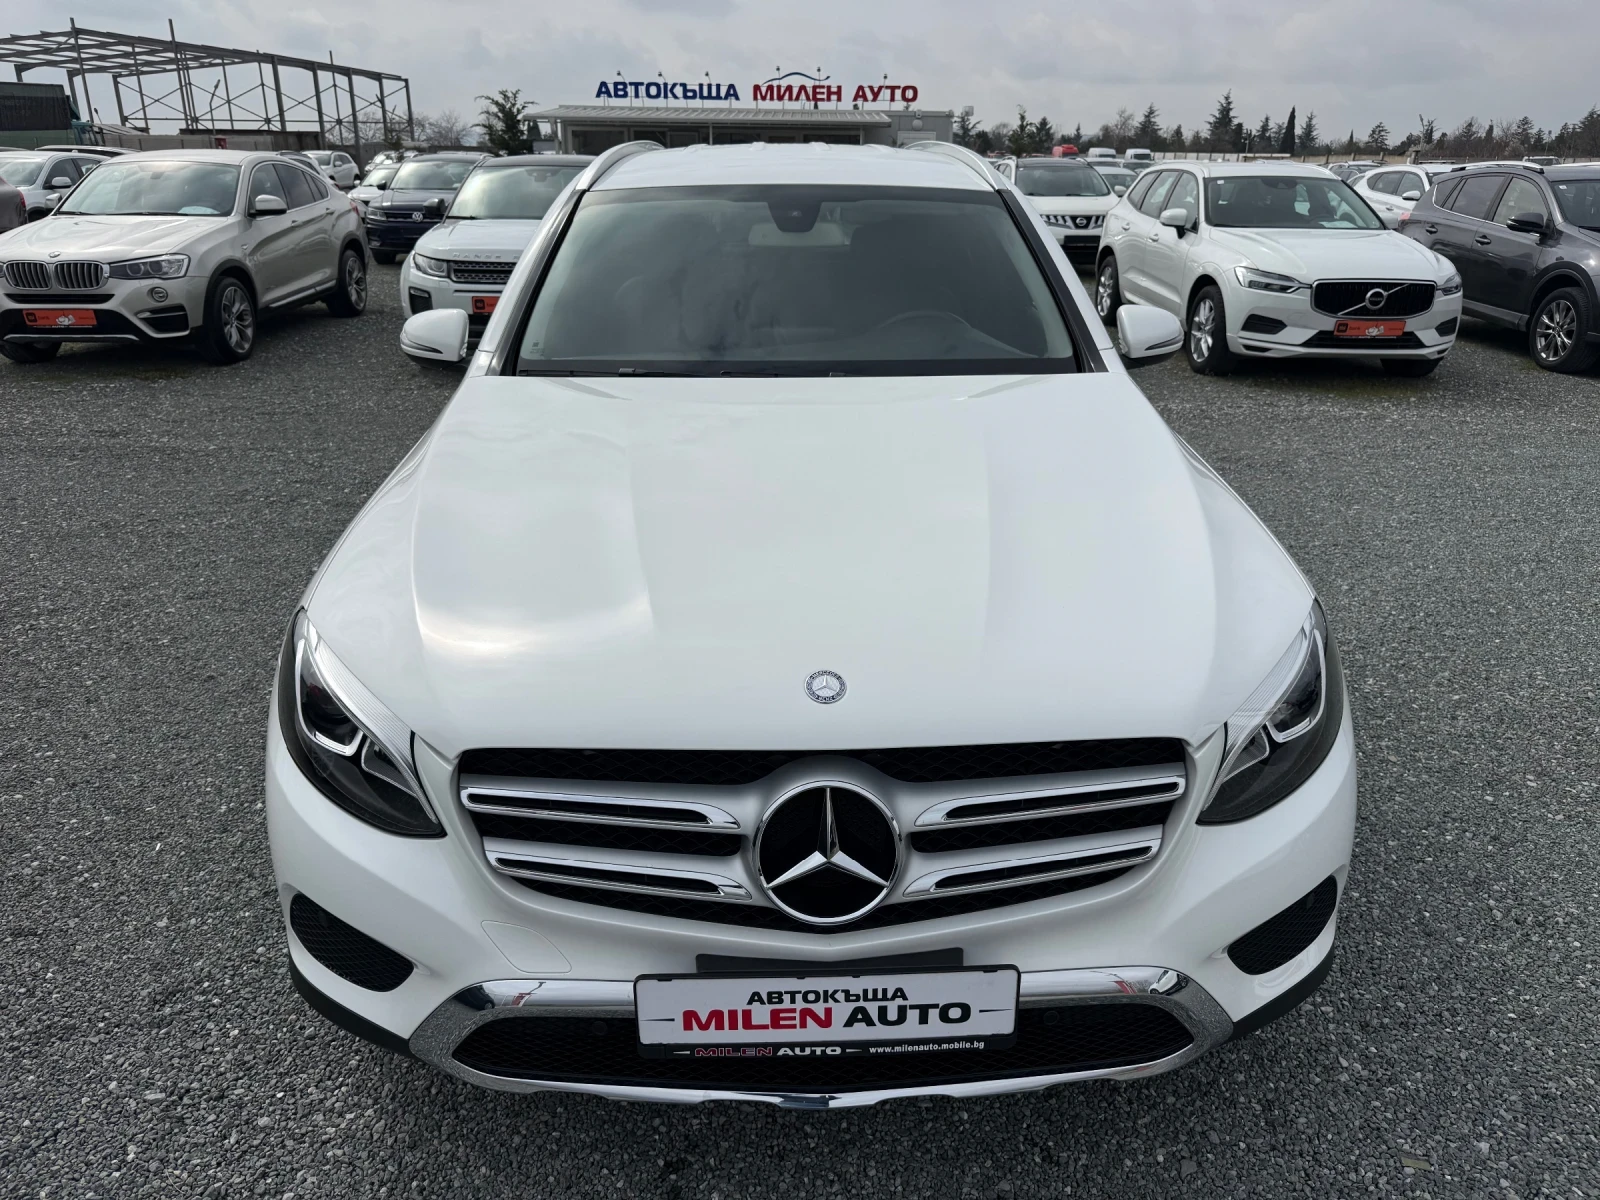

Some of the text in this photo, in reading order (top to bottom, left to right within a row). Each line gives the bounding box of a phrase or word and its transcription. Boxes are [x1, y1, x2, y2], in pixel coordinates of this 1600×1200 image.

[595, 81, 918, 103] АВТОКЪЩА МИЛЕН АУТО
[746, 987, 909, 1006] АВТОКЪЩА
[682, 1001, 972, 1031] MILEN AUTO
[694, 1046, 842, 1057] MILEN AUTO
[869, 1040, 985, 1054] www.milenauto.mobile.bg
